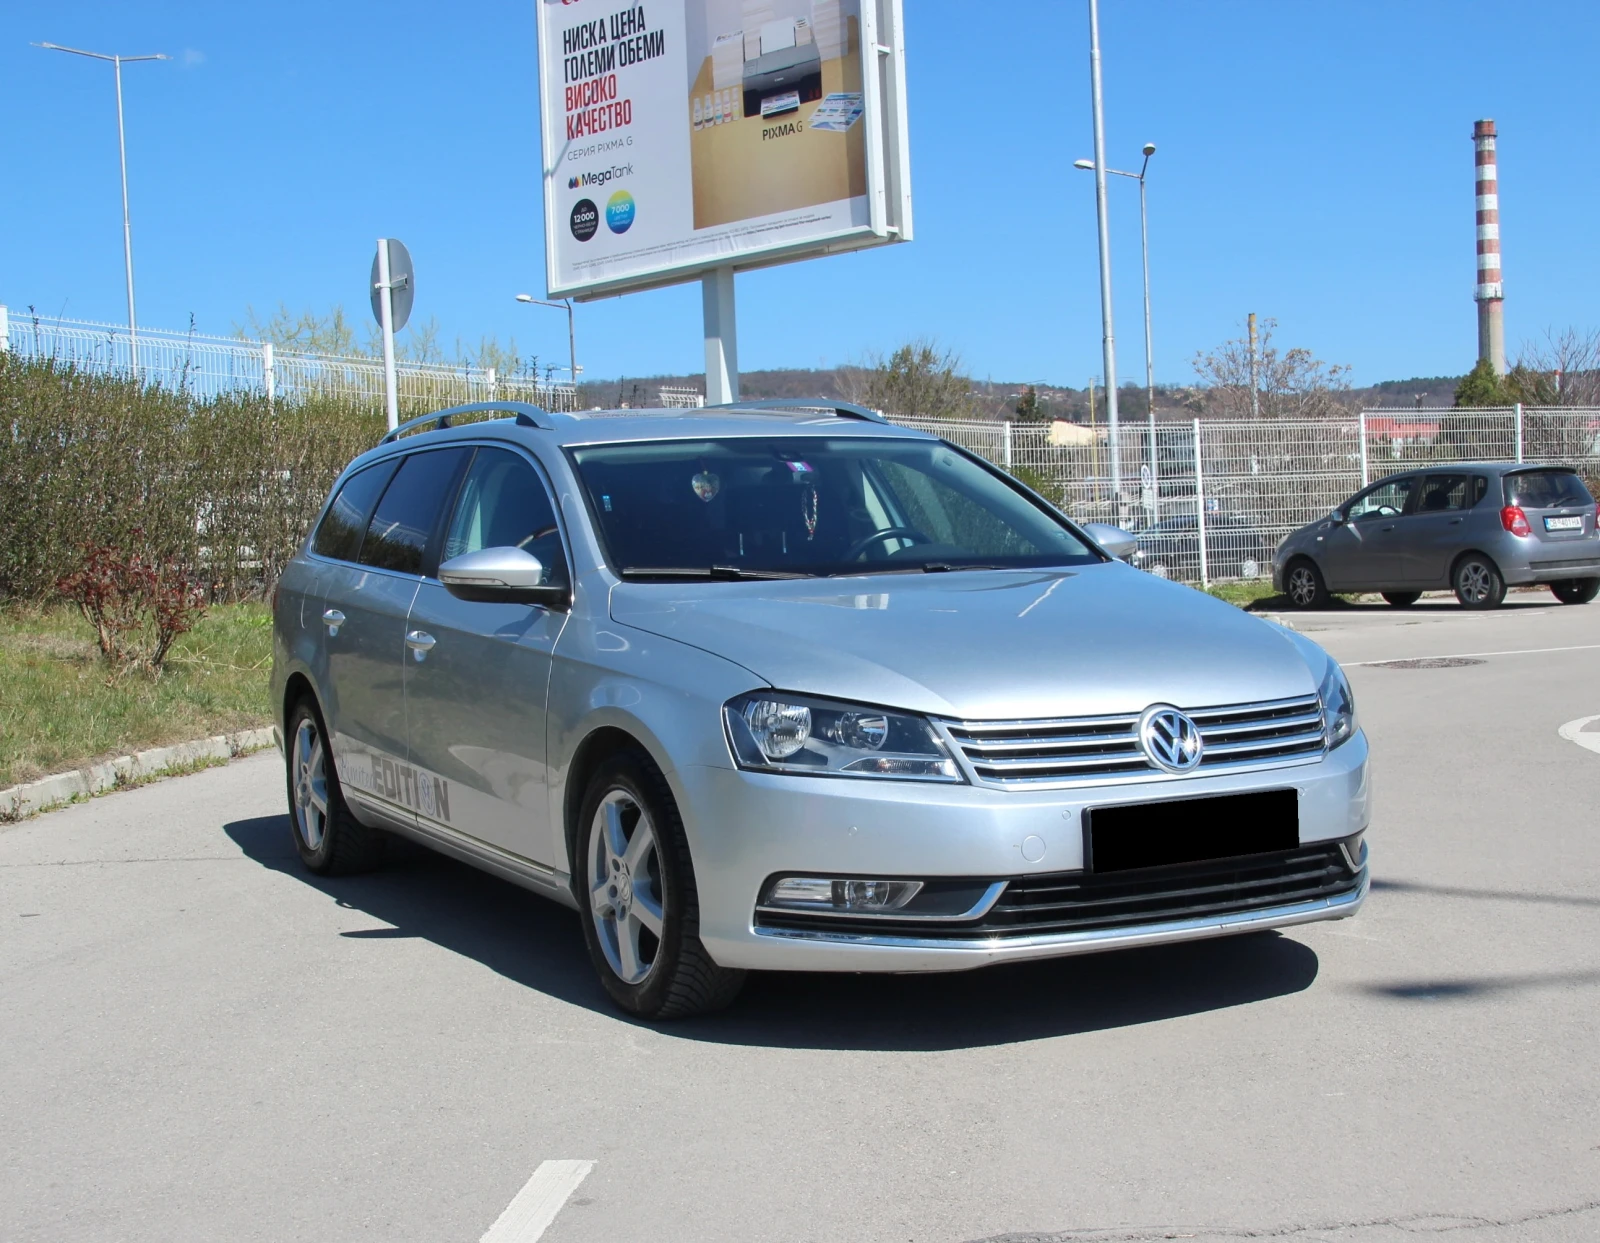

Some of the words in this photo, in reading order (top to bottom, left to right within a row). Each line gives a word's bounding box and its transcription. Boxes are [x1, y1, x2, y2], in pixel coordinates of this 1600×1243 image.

[563, 18, 607, 55] НИСКА
[610, 6, 646, 41] ЦЕНА
[564, 45, 615, 84] ГОЛЕМИ
[619, 29, 665, 67] ОБЕМИ
[565, 74, 617, 112] ВИСОКО
[566, 99, 632, 141] КАЧЕСТВО
[762, 123, 796, 141] PIXMA
[797, 121, 803, 133] G
[568, 145, 595, 161] СЕРИЯ
[598, 138, 624, 154] PIXMA
[626, 136, 633, 146] G
[582, 162, 634, 186] MegaTank
